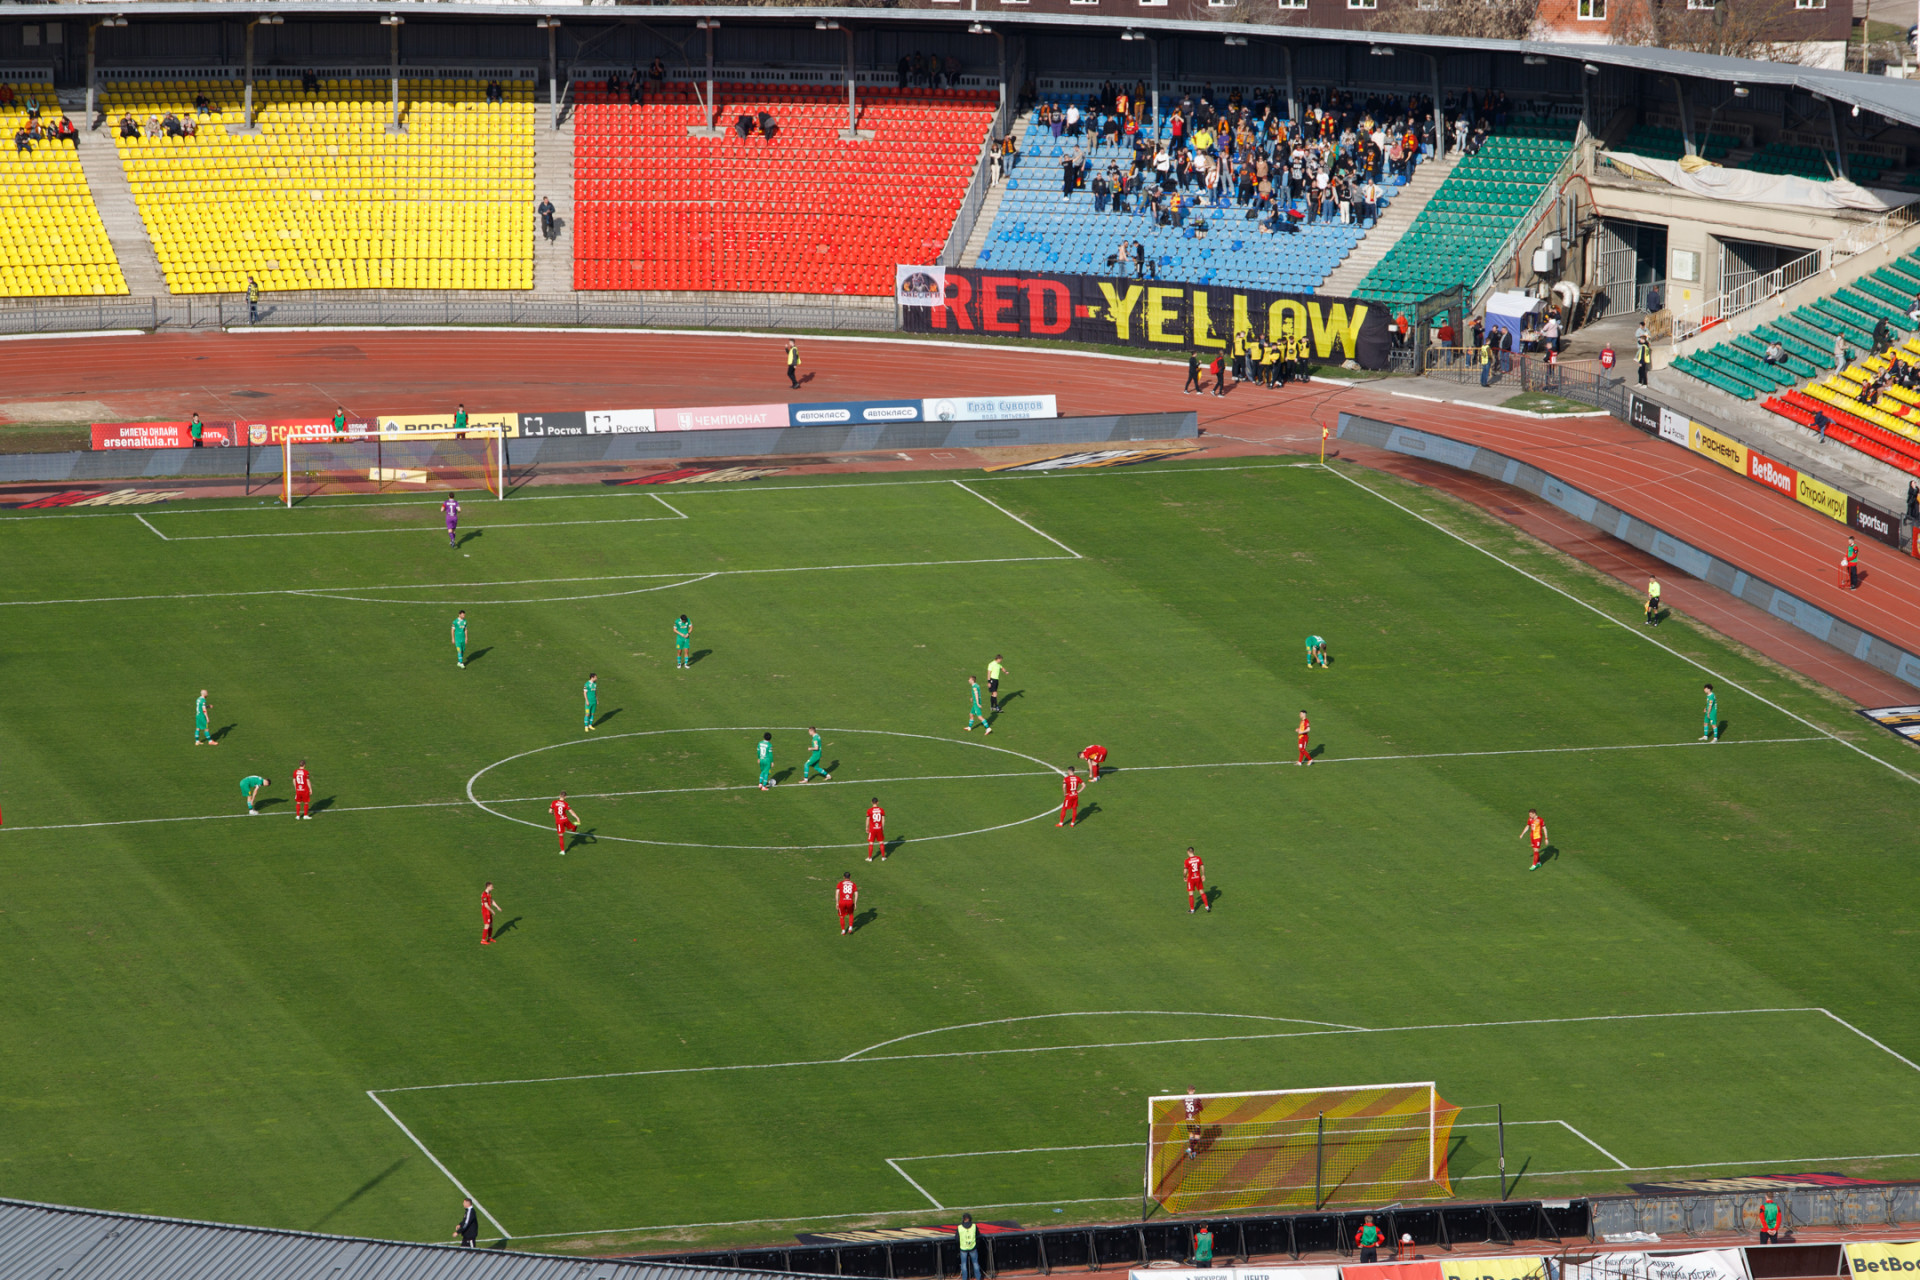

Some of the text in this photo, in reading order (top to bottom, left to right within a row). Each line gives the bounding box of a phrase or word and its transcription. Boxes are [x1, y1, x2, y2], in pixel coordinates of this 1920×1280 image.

[967, 401, 1043, 412] Граф Суворов
[695, 414, 767, 426] ЧЕМПИОНАТ
[120, 427, 178, 437] БИЛЕТЫ ОНЛАЙН
[548, 427, 582, 436] Ростех
[616, 425, 650, 433] Ростех
[104, 437, 179, 448] arsenaltula.ru
[1702, 435, 1740, 463] РОСНЕФТЬ
[1752, 456, 1791, 492] BetBoom
[1800, 480, 1845, 519] Открой игру!
[1859, 512, 1889, 535] sports.ru
[558, 807, 563, 815] 8
[872, 813, 881, 822] 90
[843, 885, 852, 894] 88
